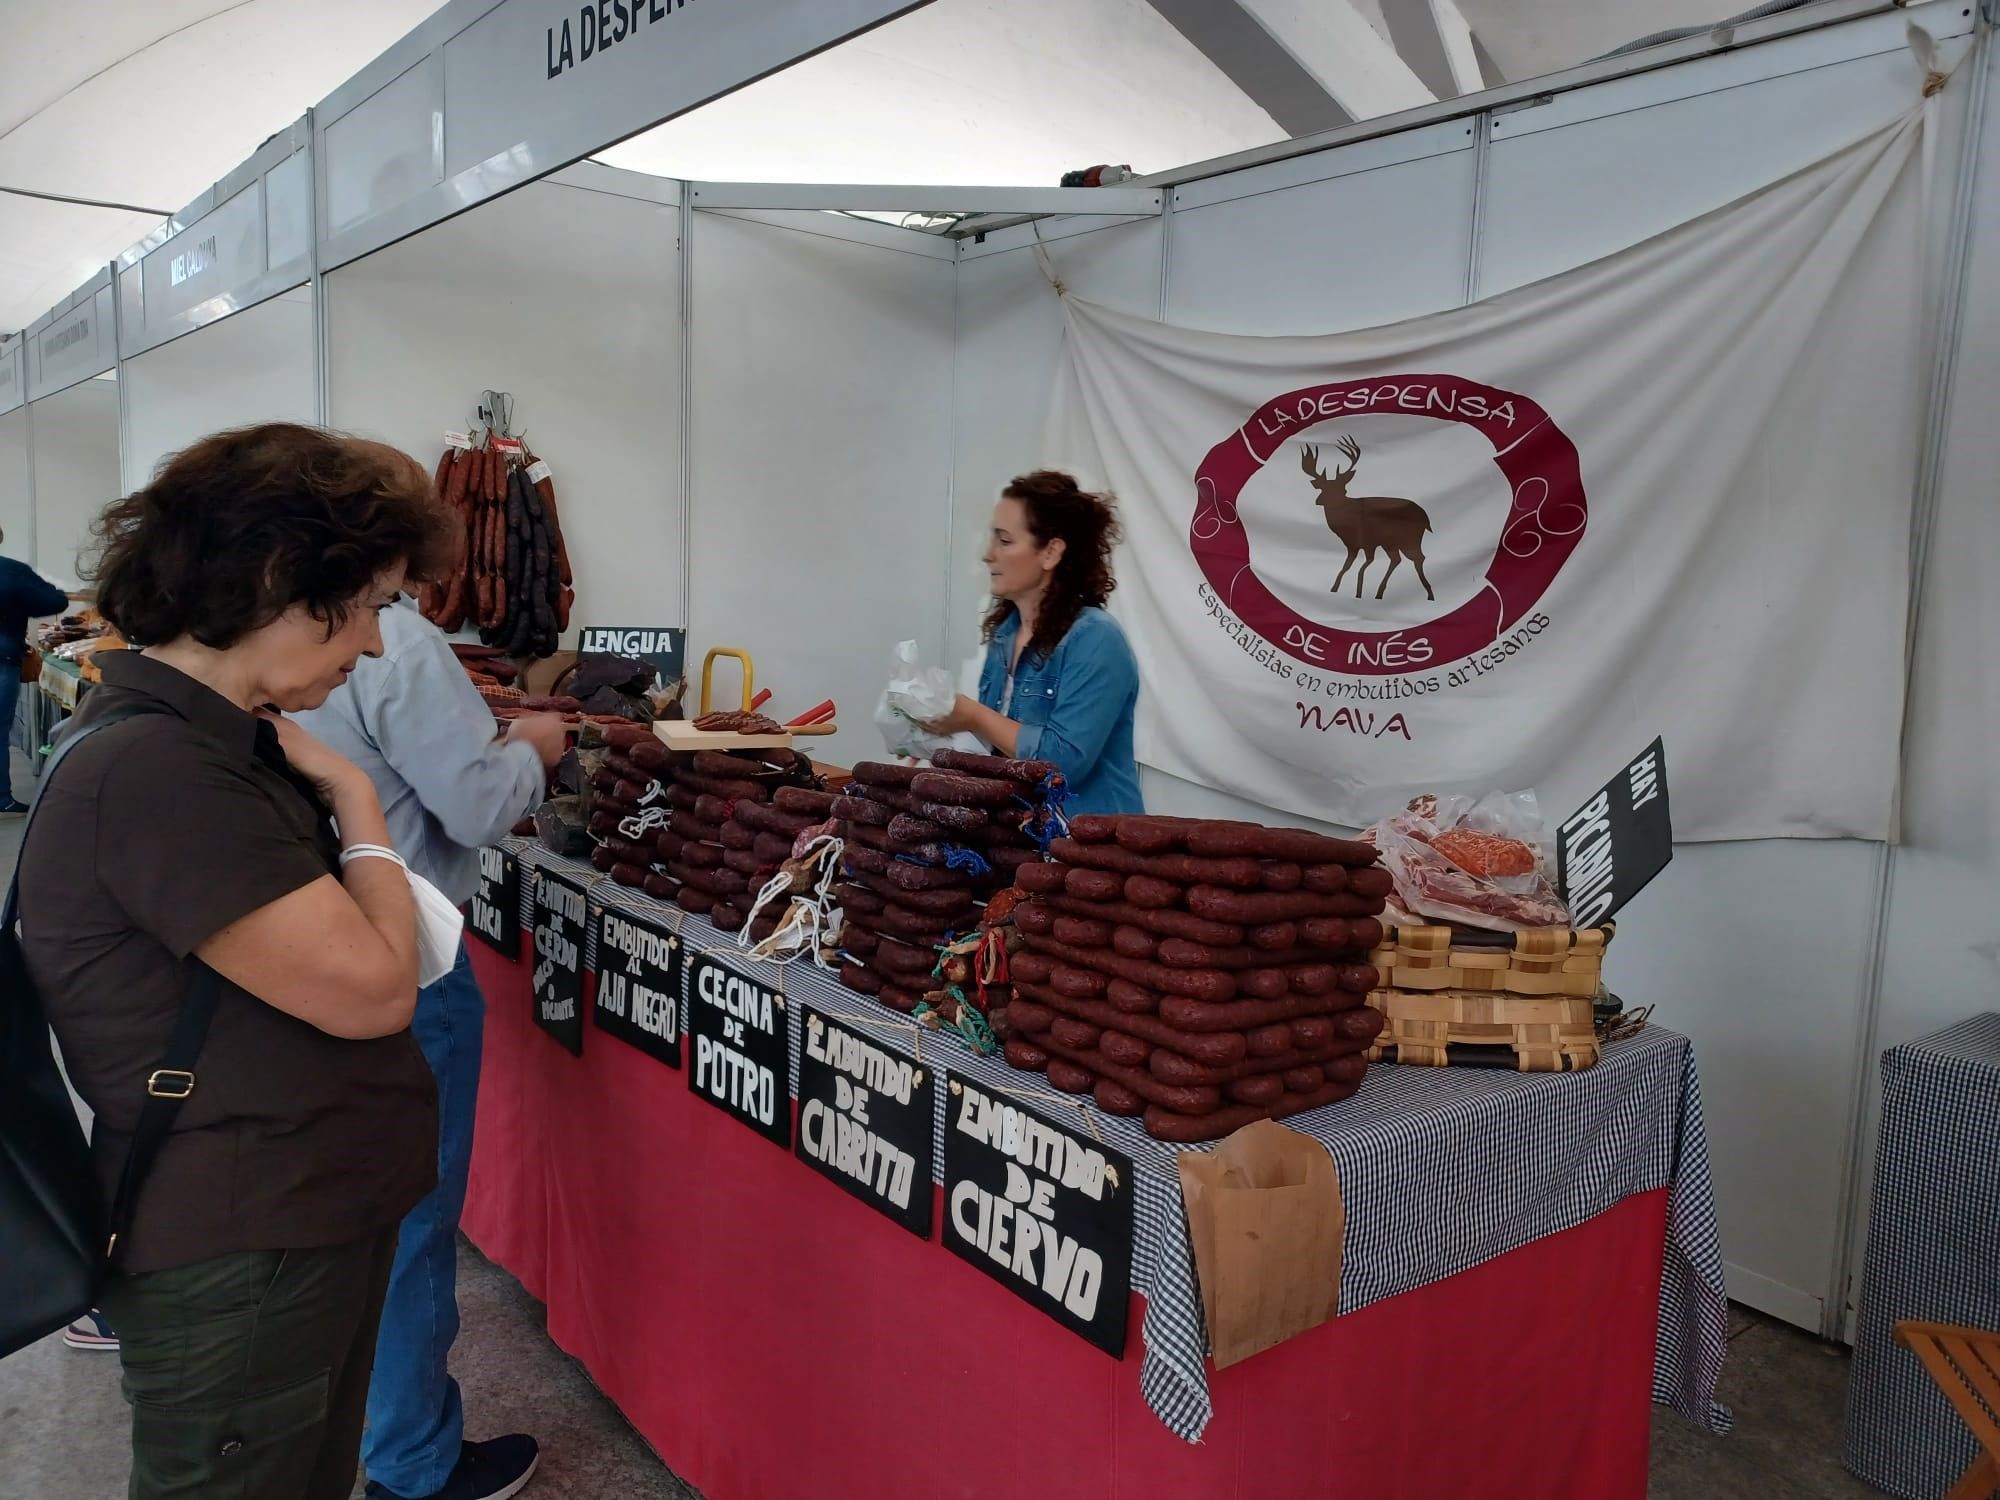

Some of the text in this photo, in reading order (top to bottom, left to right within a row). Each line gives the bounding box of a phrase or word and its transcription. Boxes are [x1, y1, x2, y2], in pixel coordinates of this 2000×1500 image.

[547, 0, 696, 80] LA DESP
[171, 253, 186, 287] MIEL
[1258, 385, 1517, 436] LA DESPENSA
[582, 630, 672, 653] LENGUA
[1282, 625, 1434, 667] DE INÉS
[1297, 672, 1321, 692] en
[1326, 675, 1441, 700] embutidos
[1447, 612, 1551, 688] artesanos
[1296, 701, 1412, 741] NAVA
[1629, 751, 1659, 811] HAY
[1562, 790, 1615, 930] PICADILLO
[472, 895, 502, 941] VACA
[603, 914, 669, 972] EMBUTIDO
[535, 924, 578, 974] CERDO
[625, 955, 642, 977] AL
[597, 969, 676, 1044] AJO NEGRO
[698, 965, 774, 1036] CECINA
[722, 1017, 745, 1047] DE
[696, 1034, 775, 1127] POTRO
[805, 1019, 915, 1106] EMBUTIDO
[834, 1075, 869, 1125] DE
[801, 1097, 916, 1210] CABRITO
[956, 1087, 1107, 1202] EMBUTIDO
[1005, 1161, 1057, 1221] DE
[951, 1180, 1103, 1323] CIERVO
